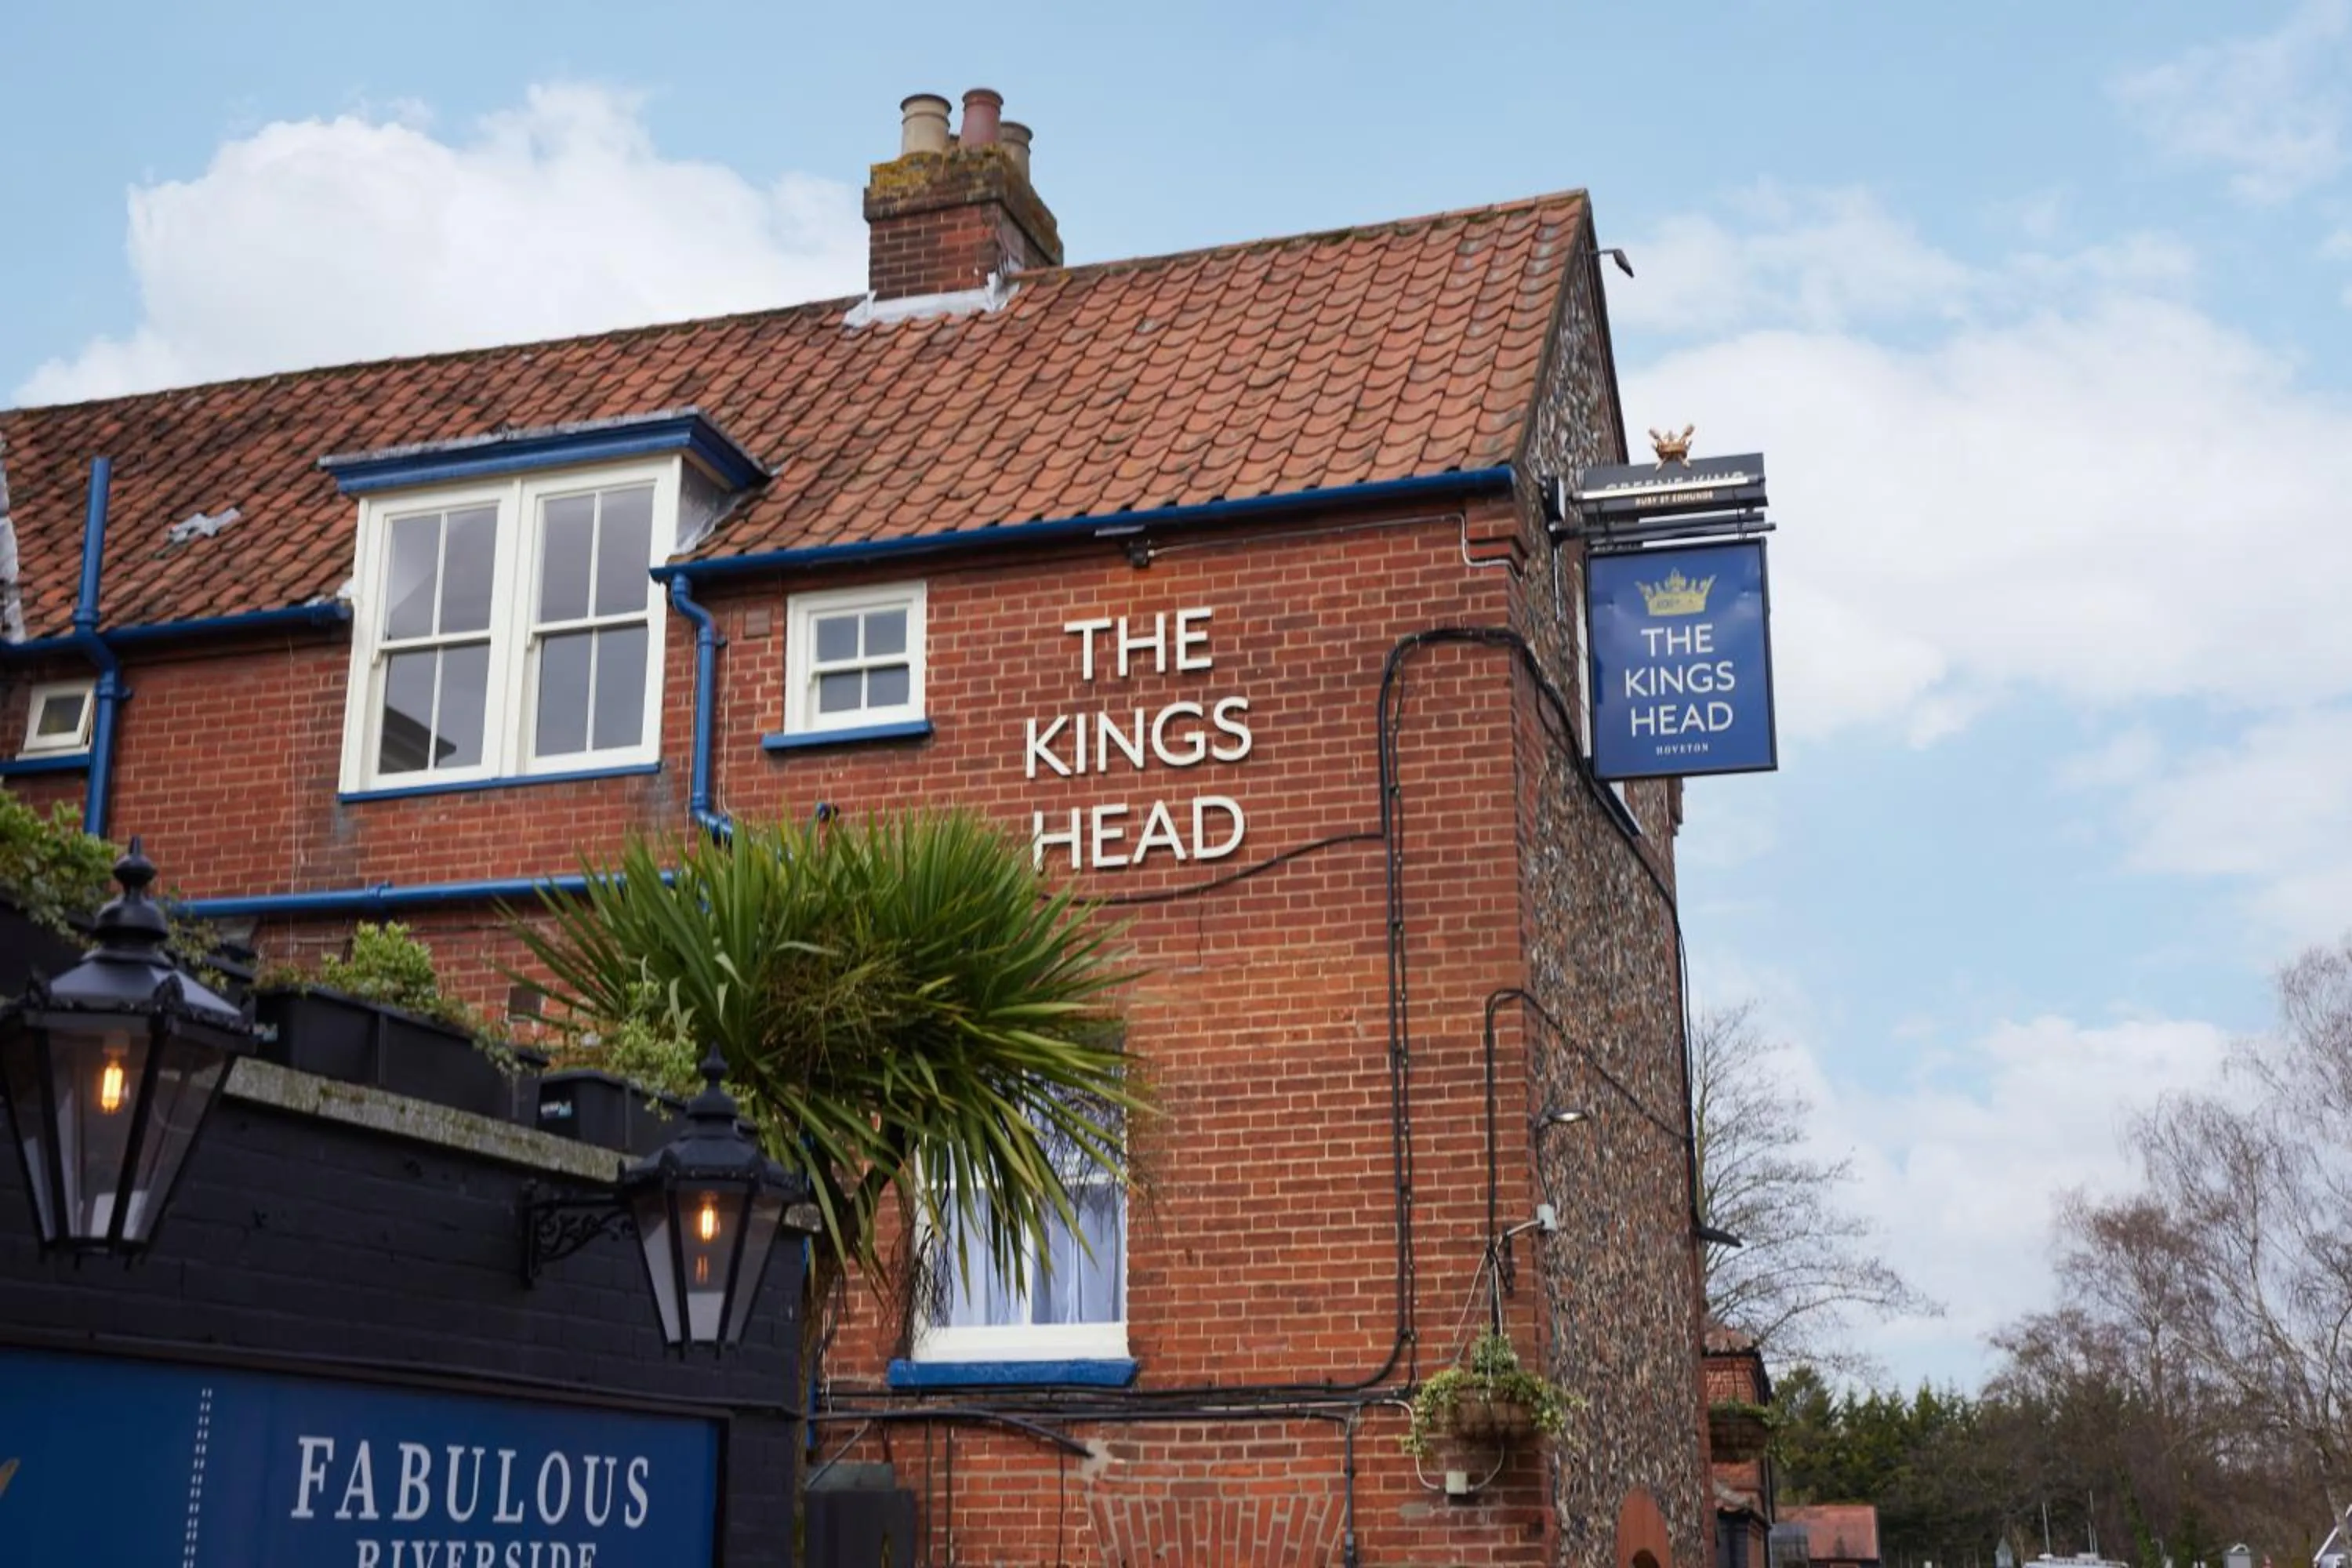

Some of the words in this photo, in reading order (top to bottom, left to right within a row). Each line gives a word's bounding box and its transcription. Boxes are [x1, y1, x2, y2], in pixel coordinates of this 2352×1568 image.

[1064, 607, 1213, 681] THE
[1640, 623, 1715, 658] THE
[1624, 661, 1735, 699] KINGS
[1025, 696, 1253, 779] KINGS
[1630, 701, 1734, 738] HEAD
[1656, 742, 1709, 757] HOVETON
[1032, 795, 1245, 872] HEAD
[290, 1436, 649, 1529] FABULOUS
[356, 1539, 597, 1568] RIVERSIDE
